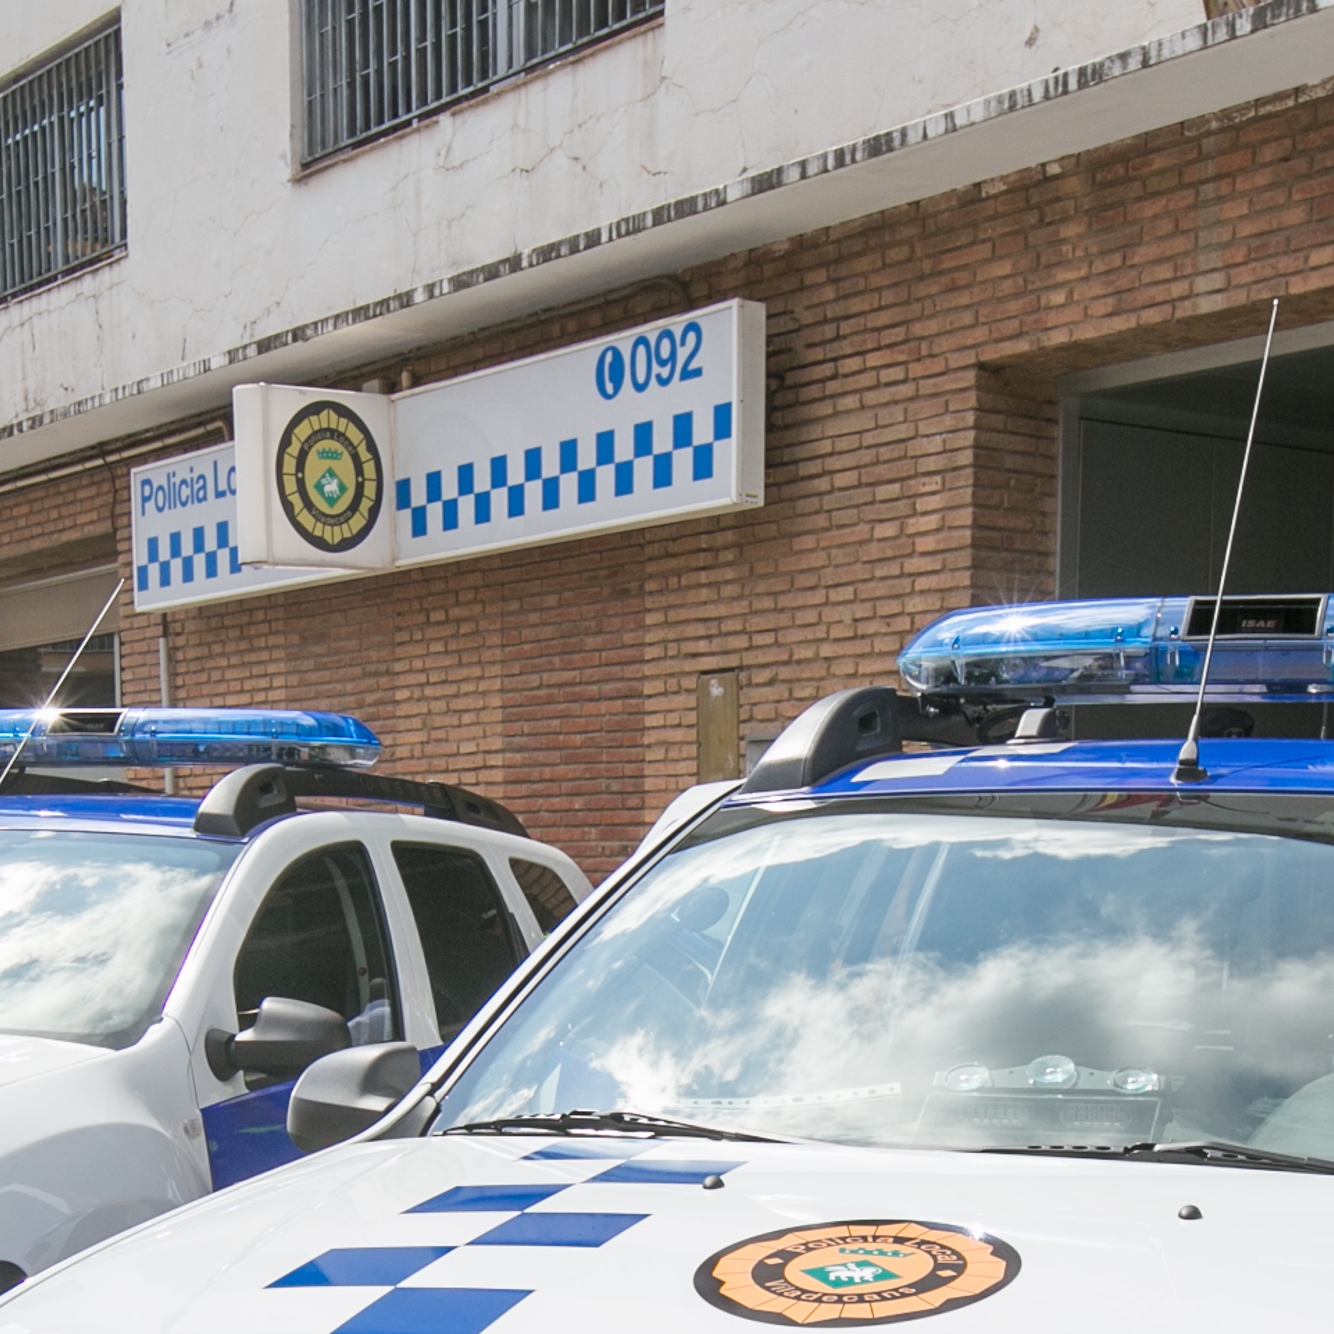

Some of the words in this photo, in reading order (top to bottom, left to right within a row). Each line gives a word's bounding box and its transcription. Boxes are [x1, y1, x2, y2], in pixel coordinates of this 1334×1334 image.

[630, 321, 703, 393] 092
[140, 466, 208, 517] Policia
[784, 1236, 894, 1254] Policia
[903, 1238, 964, 1264] Local
[764, 1278, 917, 1303] Viladecans
